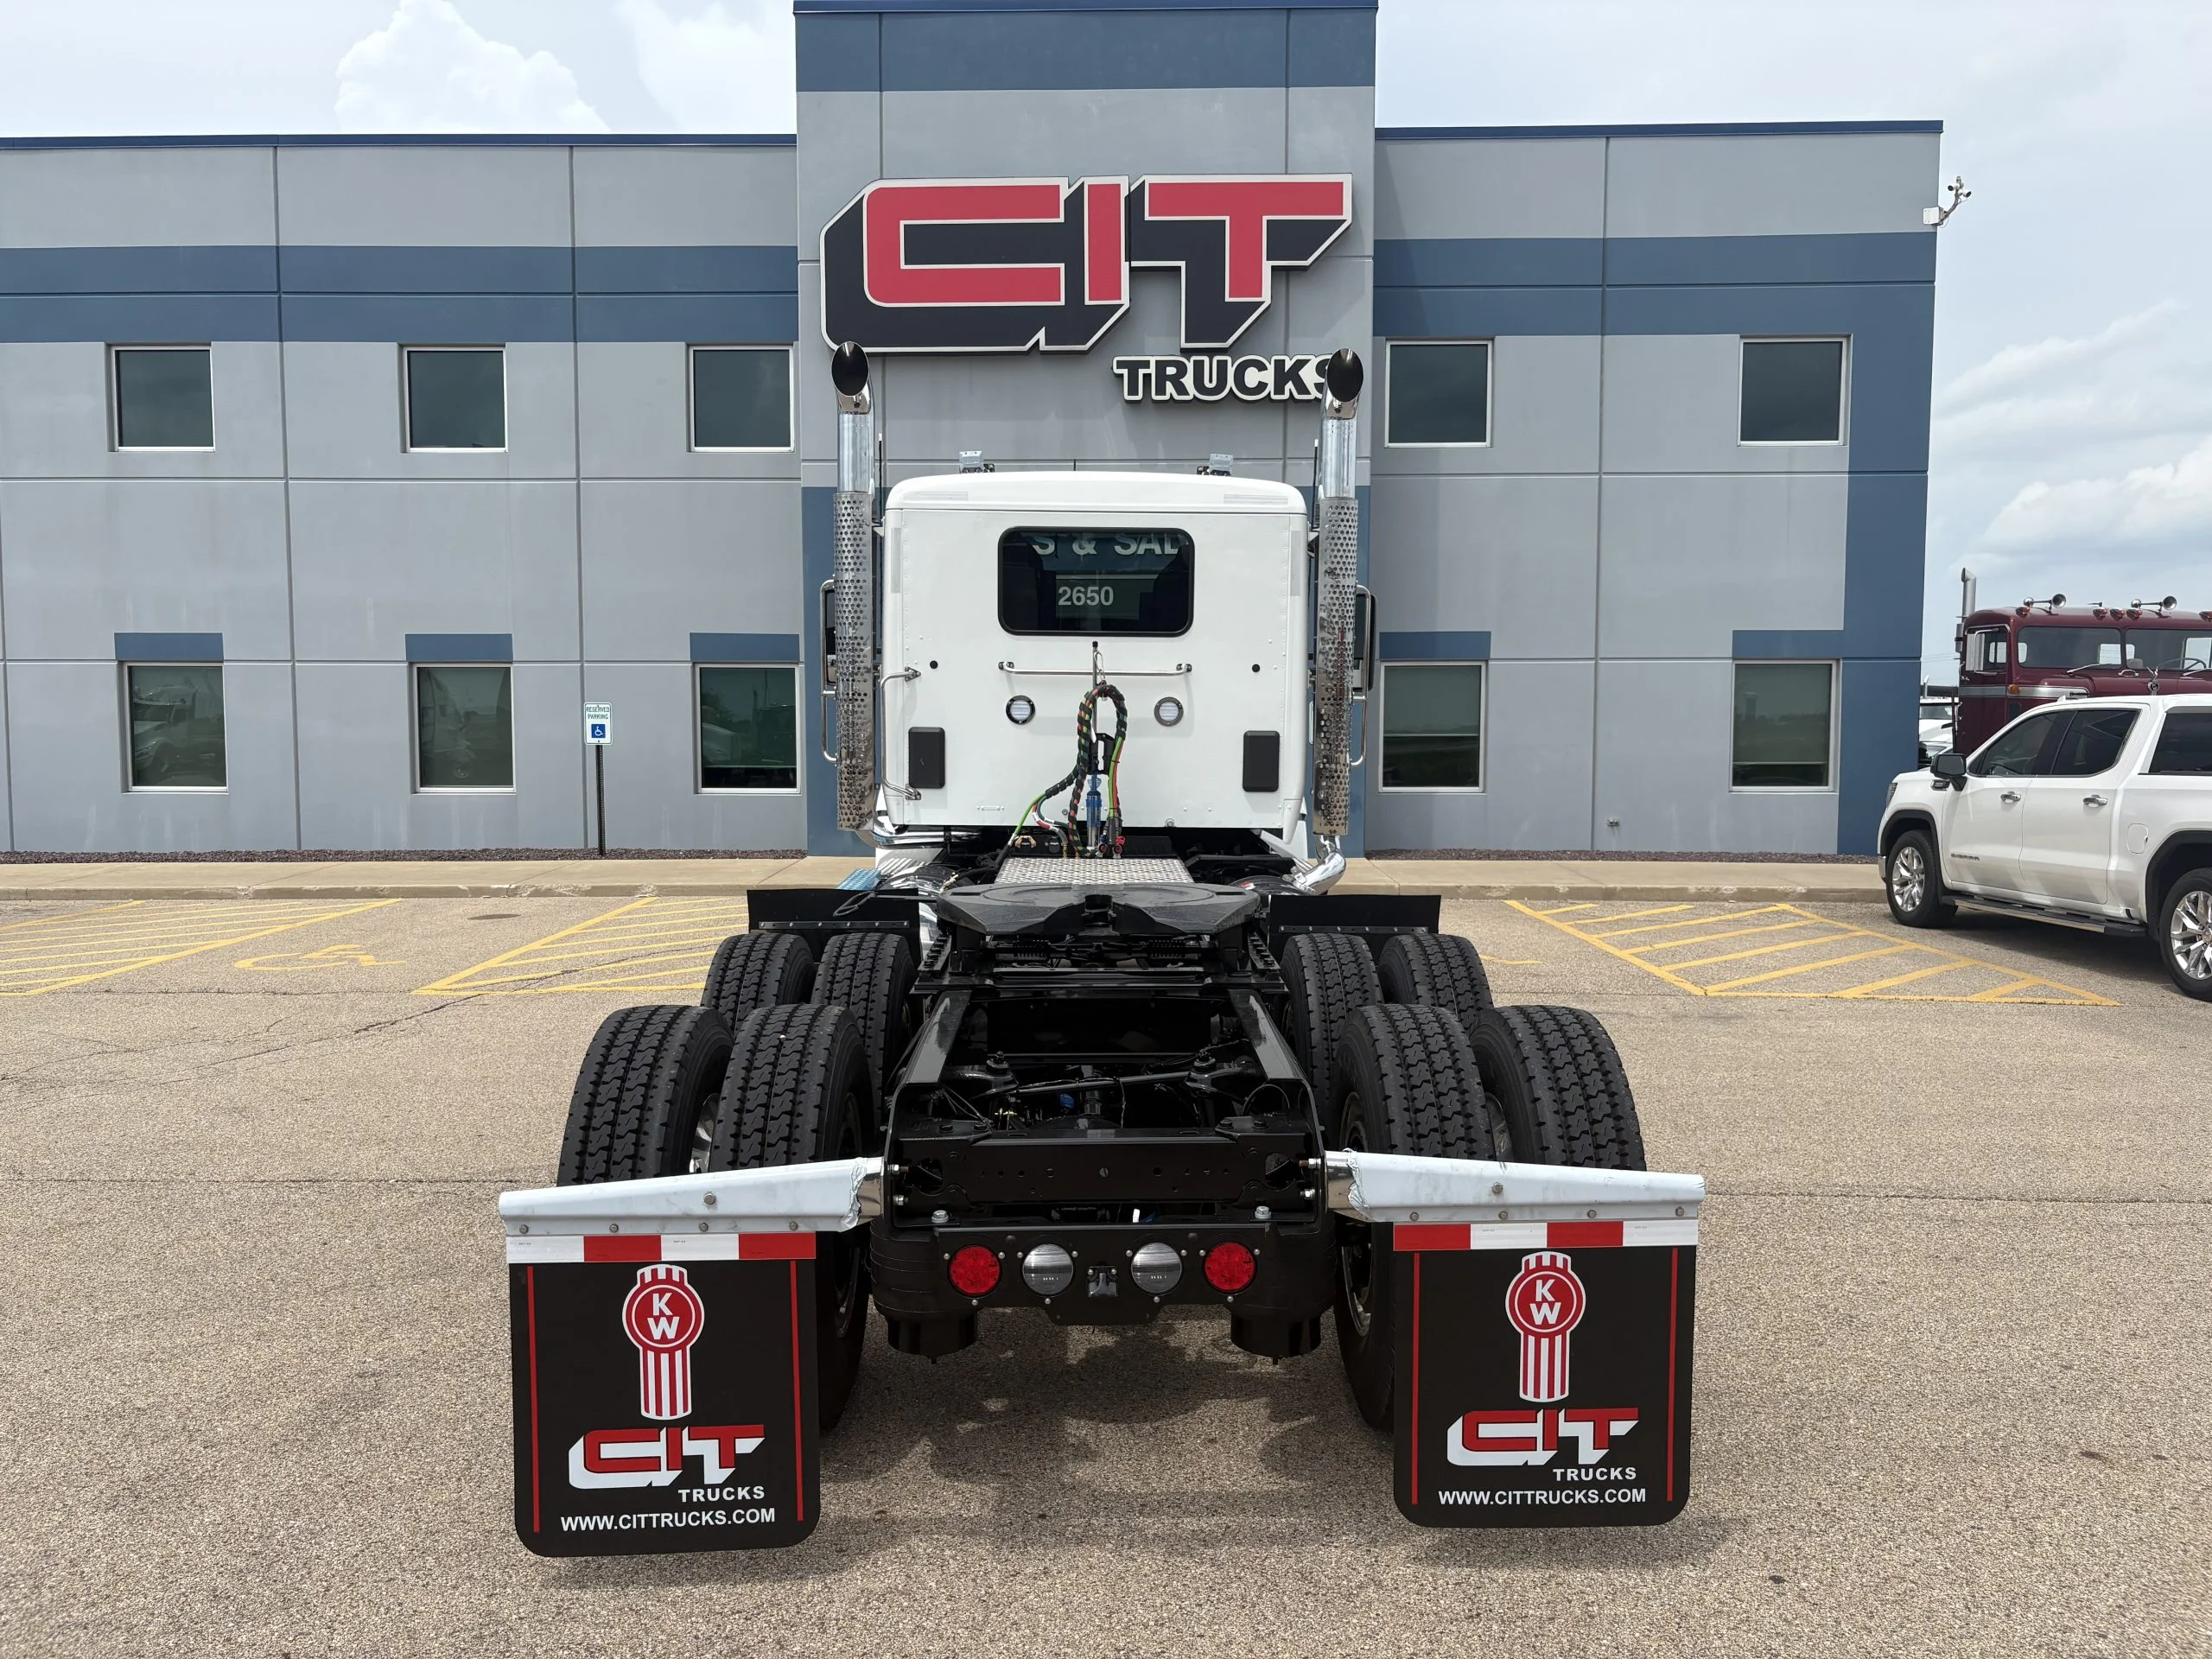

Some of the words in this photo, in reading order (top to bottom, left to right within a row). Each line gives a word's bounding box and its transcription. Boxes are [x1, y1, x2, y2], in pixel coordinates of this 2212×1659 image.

[821, 175, 1351, 353] CIT
[1072, 535, 1097, 555] &
[1058, 586, 1114, 606] 2650
[1535, 1279, 1555, 1301] K
[652, 1293, 673, 1316] K
[1529, 1302, 1561, 1325] W
[647, 1316, 680, 1340] W
[1447, 1408, 1639, 1466] CIT
[569, 1424, 766, 1490] CIT
[1553, 1467, 1637, 1482] TRUCKS
[678, 1485, 766, 1503] TRUCKS
[1438, 1488, 1646, 1505] WWW.CITTRUCKS.COM
[561, 1508, 775, 1532] WWW.CITTRUCKS.COM
